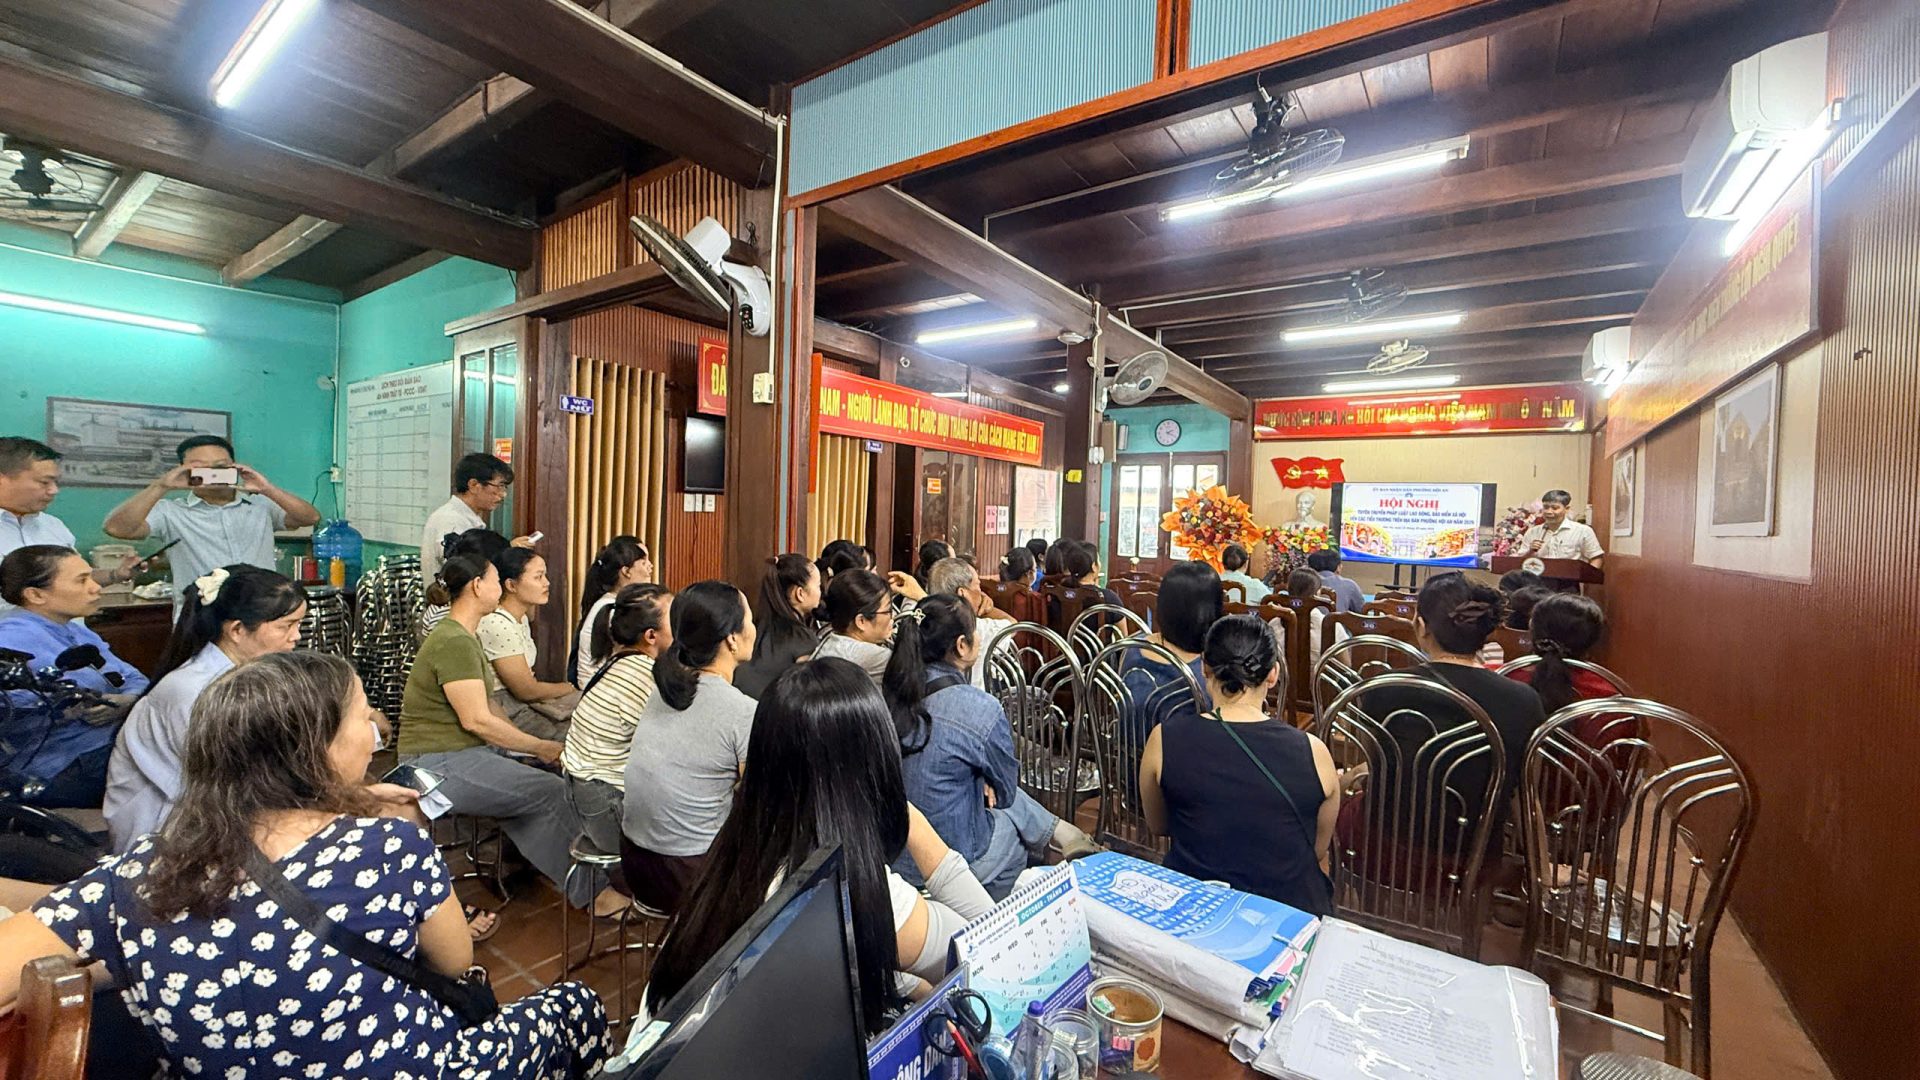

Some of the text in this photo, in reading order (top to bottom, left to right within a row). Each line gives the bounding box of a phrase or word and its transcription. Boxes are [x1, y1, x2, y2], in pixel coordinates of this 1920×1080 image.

[711, 353, 727, 397] ĐẢ
[572, 398, 588, 406] WC
[820, 386, 840, 417] NAM
[847, 389, 872, 424] NGƯỜI
[873, 394, 893, 427] LÃNH
[893, 402, 909, 434] ĐẠO,
[910, 398, 920, 432] TỔ
[920, 406, 937, 435] CHỨC
[1357, 405, 1375, 425] HỘI
[1438, 400, 1465, 425] VIỆT
[1464, 403, 1497, 421] NAM
[1542, 395, 1576, 419] NĂM
[1380, 497, 1439, 511] HỘI NGHỊ
[1021, 900, 1044, 920] OCTOBER
[1047, 887, 1063, 903] THÁNG
[972, 965, 984, 977] MON
[991, 952, 1001, 963] TUE
[1008, 940, 1019, 951] WED
[1024, 928, 1034, 938] THU
